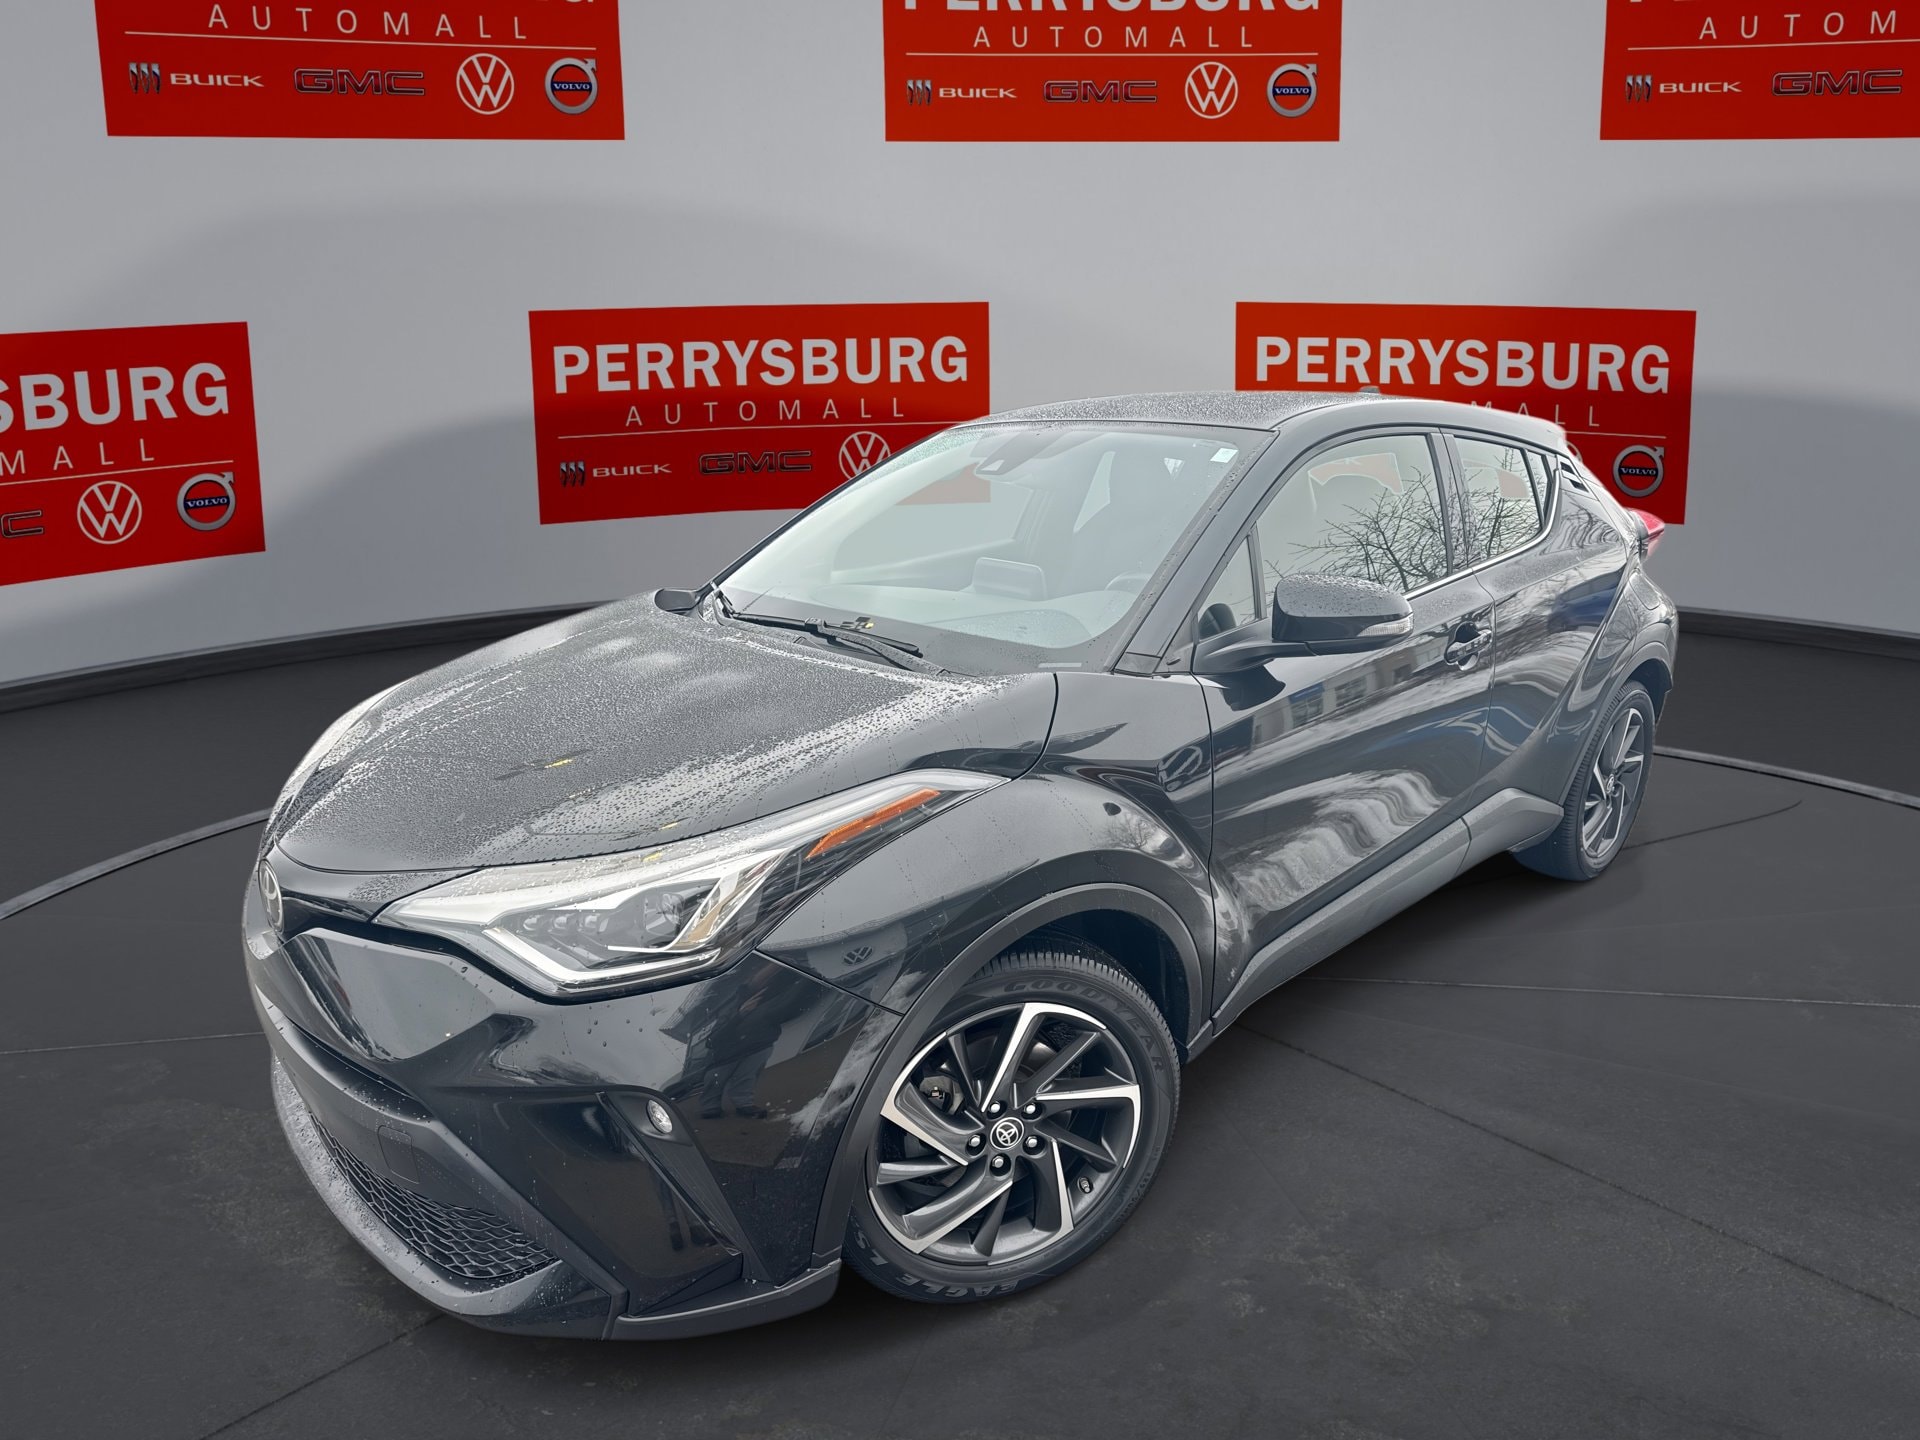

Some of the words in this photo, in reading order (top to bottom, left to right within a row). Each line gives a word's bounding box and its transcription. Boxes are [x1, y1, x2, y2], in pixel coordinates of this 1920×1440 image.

[208, 4, 526, 39] AUTOMALL
[1699, 10, 1896, 39] AUTOM
[974, 27, 1252, 48] AUTOMALL
[170, 73, 264, 87] BUICK
[294, 68, 425, 95] GMC
[554, 82, 590, 91] VOLVO
[939, 87, 1016, 98] BUICK
[1043, 80, 1157, 103] GMC
[1275, 87, 1310, 95] VOLVO
[1659, 82, 1742, 93] BUICK
[1772, 69, 1903, 96] GMC
[553, 336, 968, 394] PERRYSBURG
[1256, 336, 1670, 394] PERRYSBURG
[625, 398, 905, 427] AUTOMALL
[592, 464, 672, 478] BUICK
[699, 450, 812, 475] GMC
[1620, 467, 1657, 476] VOLVO
[186, 497, 229, 507] VOLVO
